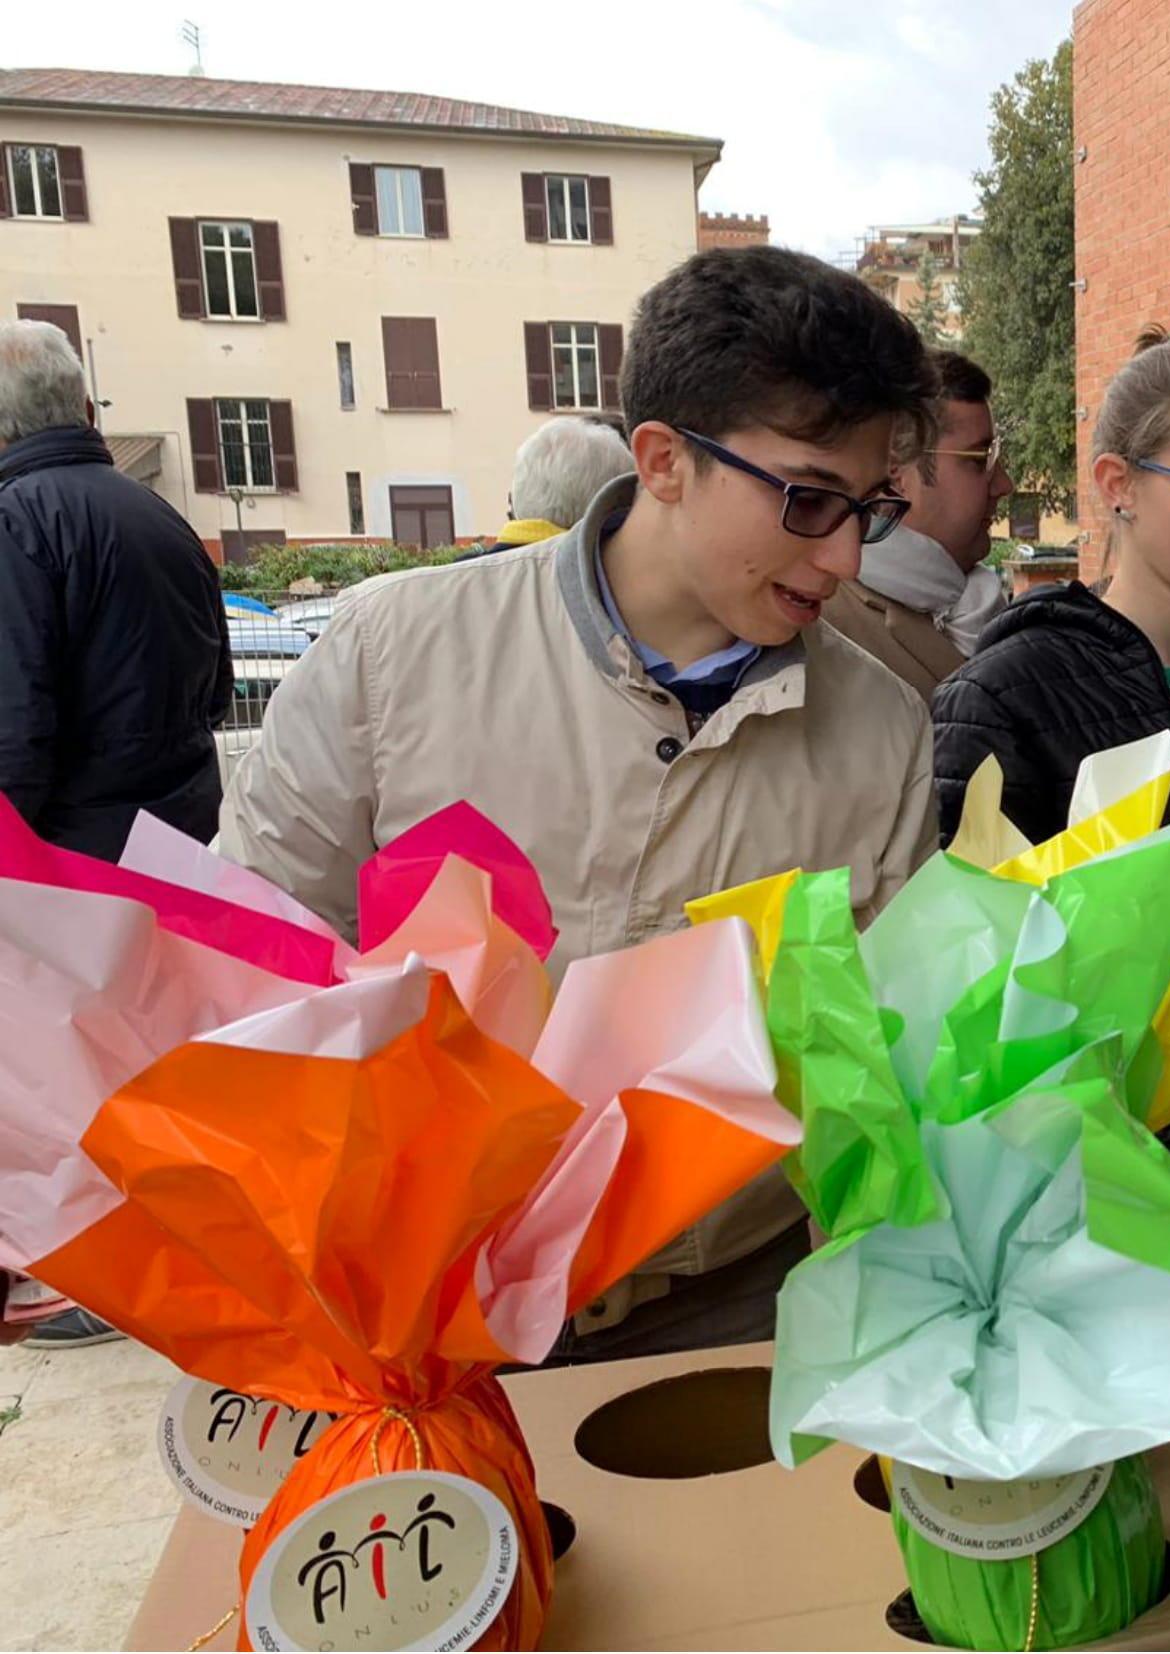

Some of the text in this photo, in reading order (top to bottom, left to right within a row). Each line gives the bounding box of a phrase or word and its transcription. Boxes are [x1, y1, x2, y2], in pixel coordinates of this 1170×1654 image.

[164, 1415, 187, 1480] ASSOCIAZIONE
[182, 1474, 214, 1506] ITALIANA
[214, 1500, 249, 1520] CONTRO
[899, 1487, 946, 1537] ASSOCIAZIONE
[946, 1531, 985, 1549] ITALIANA
[986, 1537, 1023, 1551] CONTRO
[1023, 1531, 1037, 1545] LE
